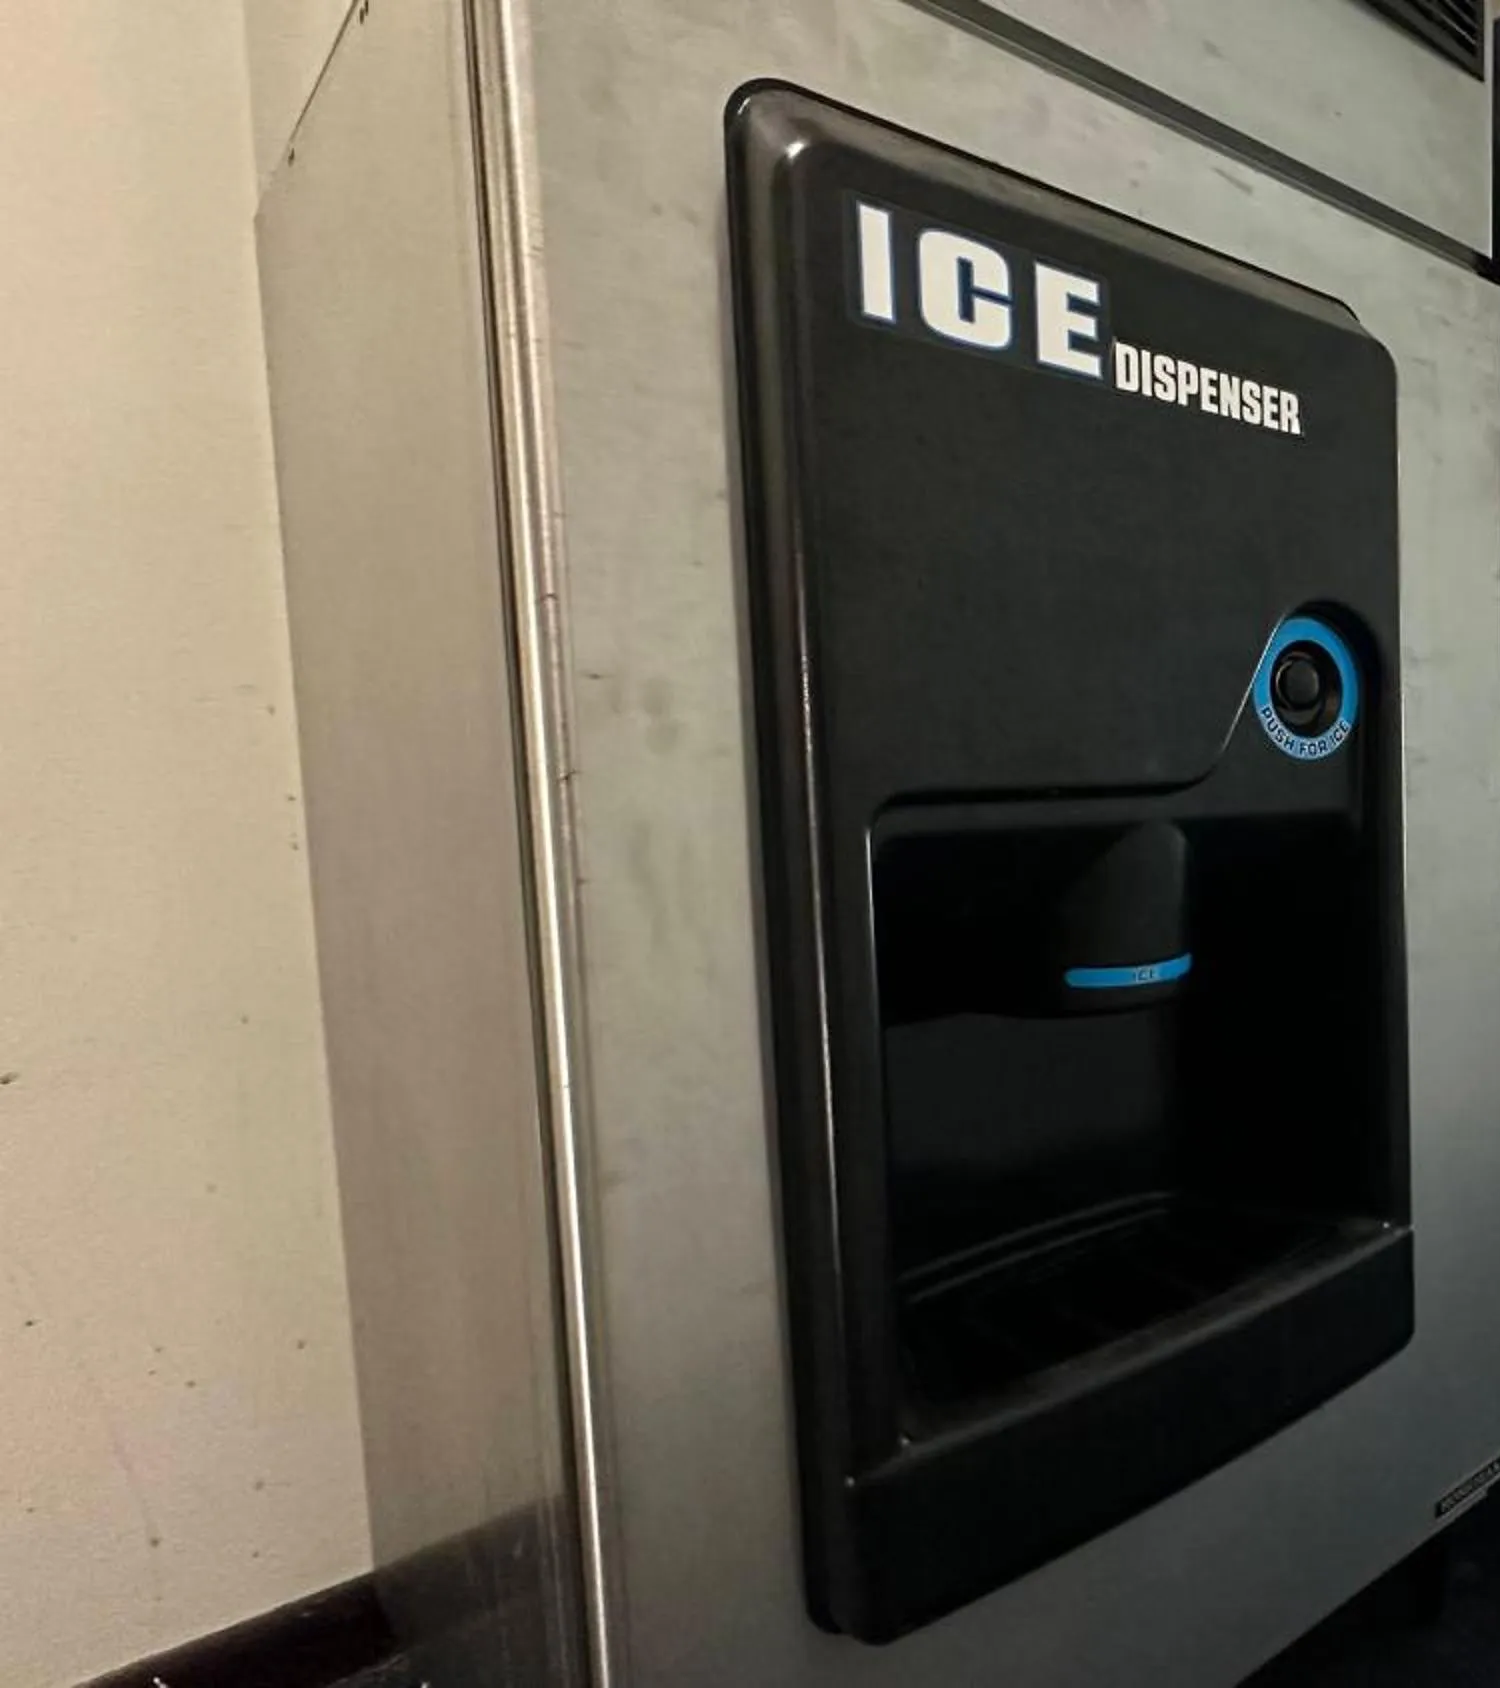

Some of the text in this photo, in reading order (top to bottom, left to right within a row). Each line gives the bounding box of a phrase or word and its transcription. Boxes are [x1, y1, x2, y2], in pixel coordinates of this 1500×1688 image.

[857, 203, 1301, 435] ICE DISPENSER
[1261, 706, 1350, 756] PUSH FOR ICE
